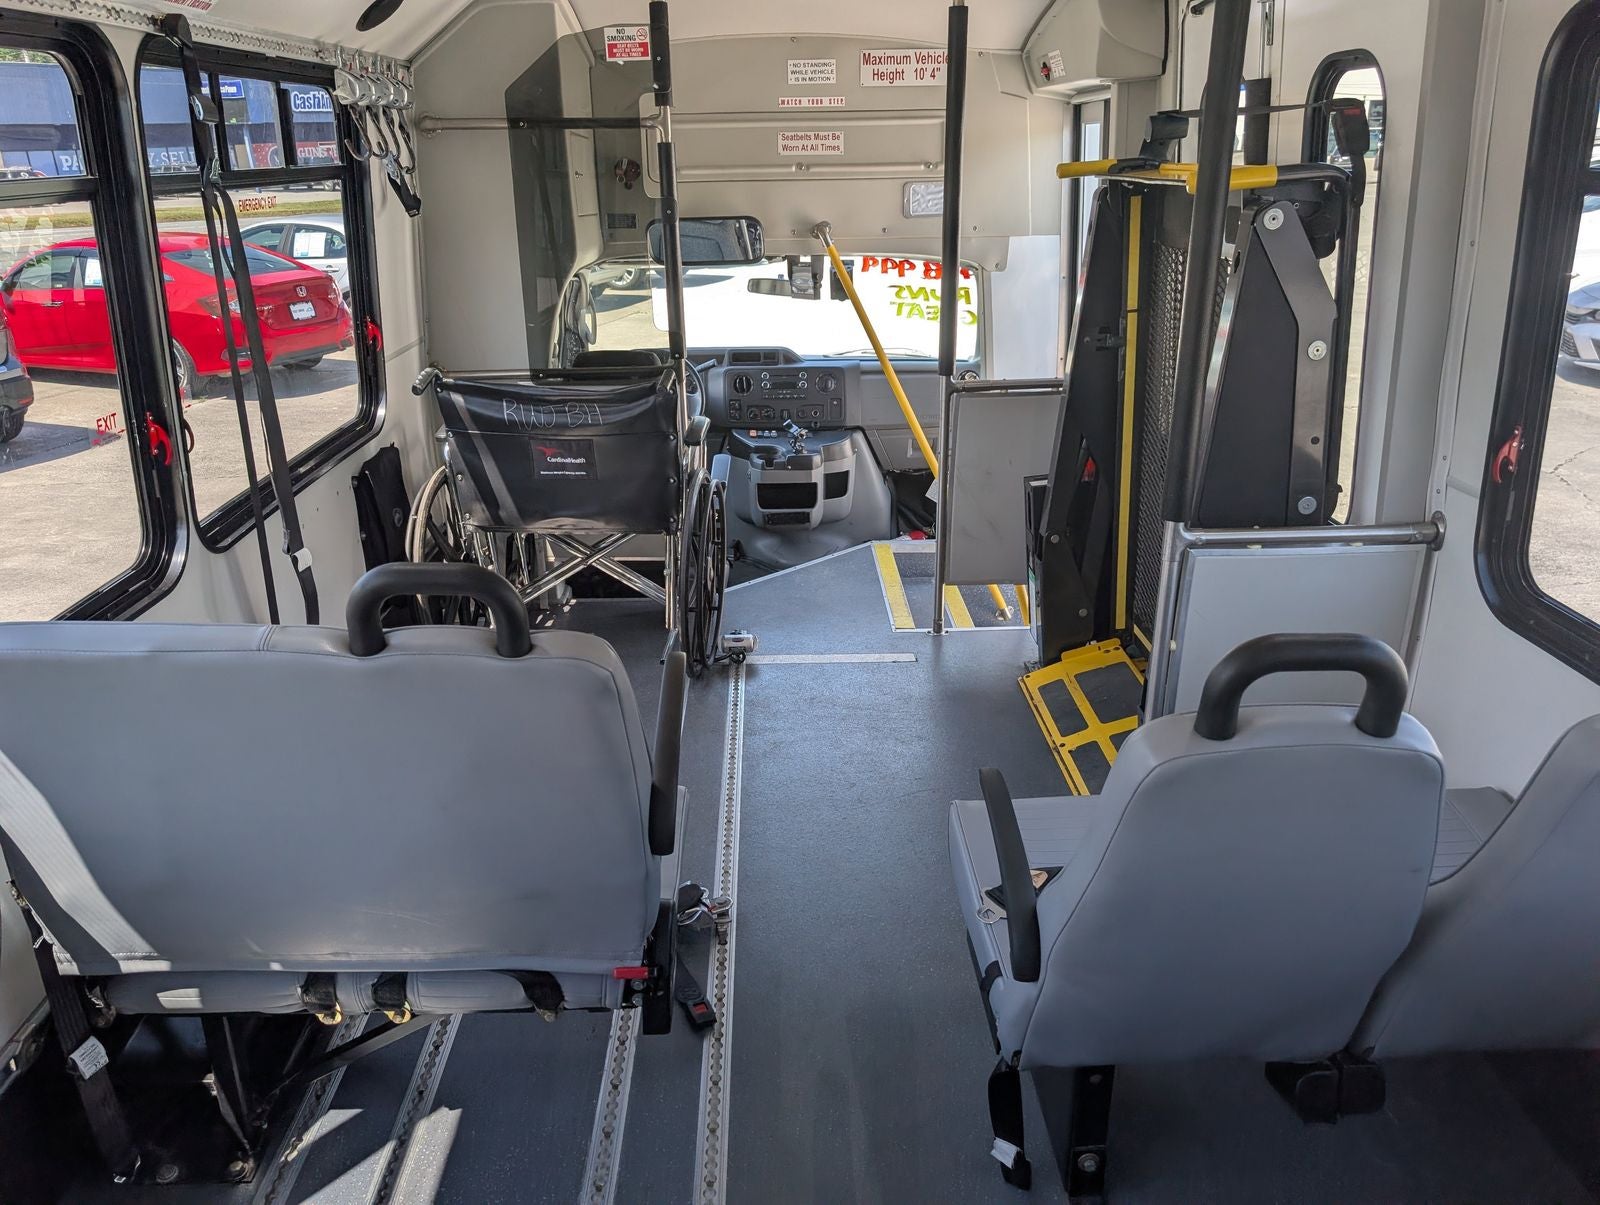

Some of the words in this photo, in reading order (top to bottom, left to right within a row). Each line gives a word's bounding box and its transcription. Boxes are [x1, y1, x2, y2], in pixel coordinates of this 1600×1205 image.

[862, 52, 912, 66] Maximum
[872, 68, 905, 84] Height
[914, 68, 928, 80] 10'
[929, 67, 941, 80] 4"
[780, 98, 802, 106] WATCH
[781, 133, 812, 141] Seatbelts
[813, 133, 830, 141] Must
[831, 133, 841, 141] Be
[781, 144, 800, 152] Worn
[800, 144, 809, 152] At
[820, 143, 841, 151] Times
[238, 197, 267, 212] EMERGENCY
[267, 195, 277, 208] EXIT
[95, 412, 117, 433] EXIT
